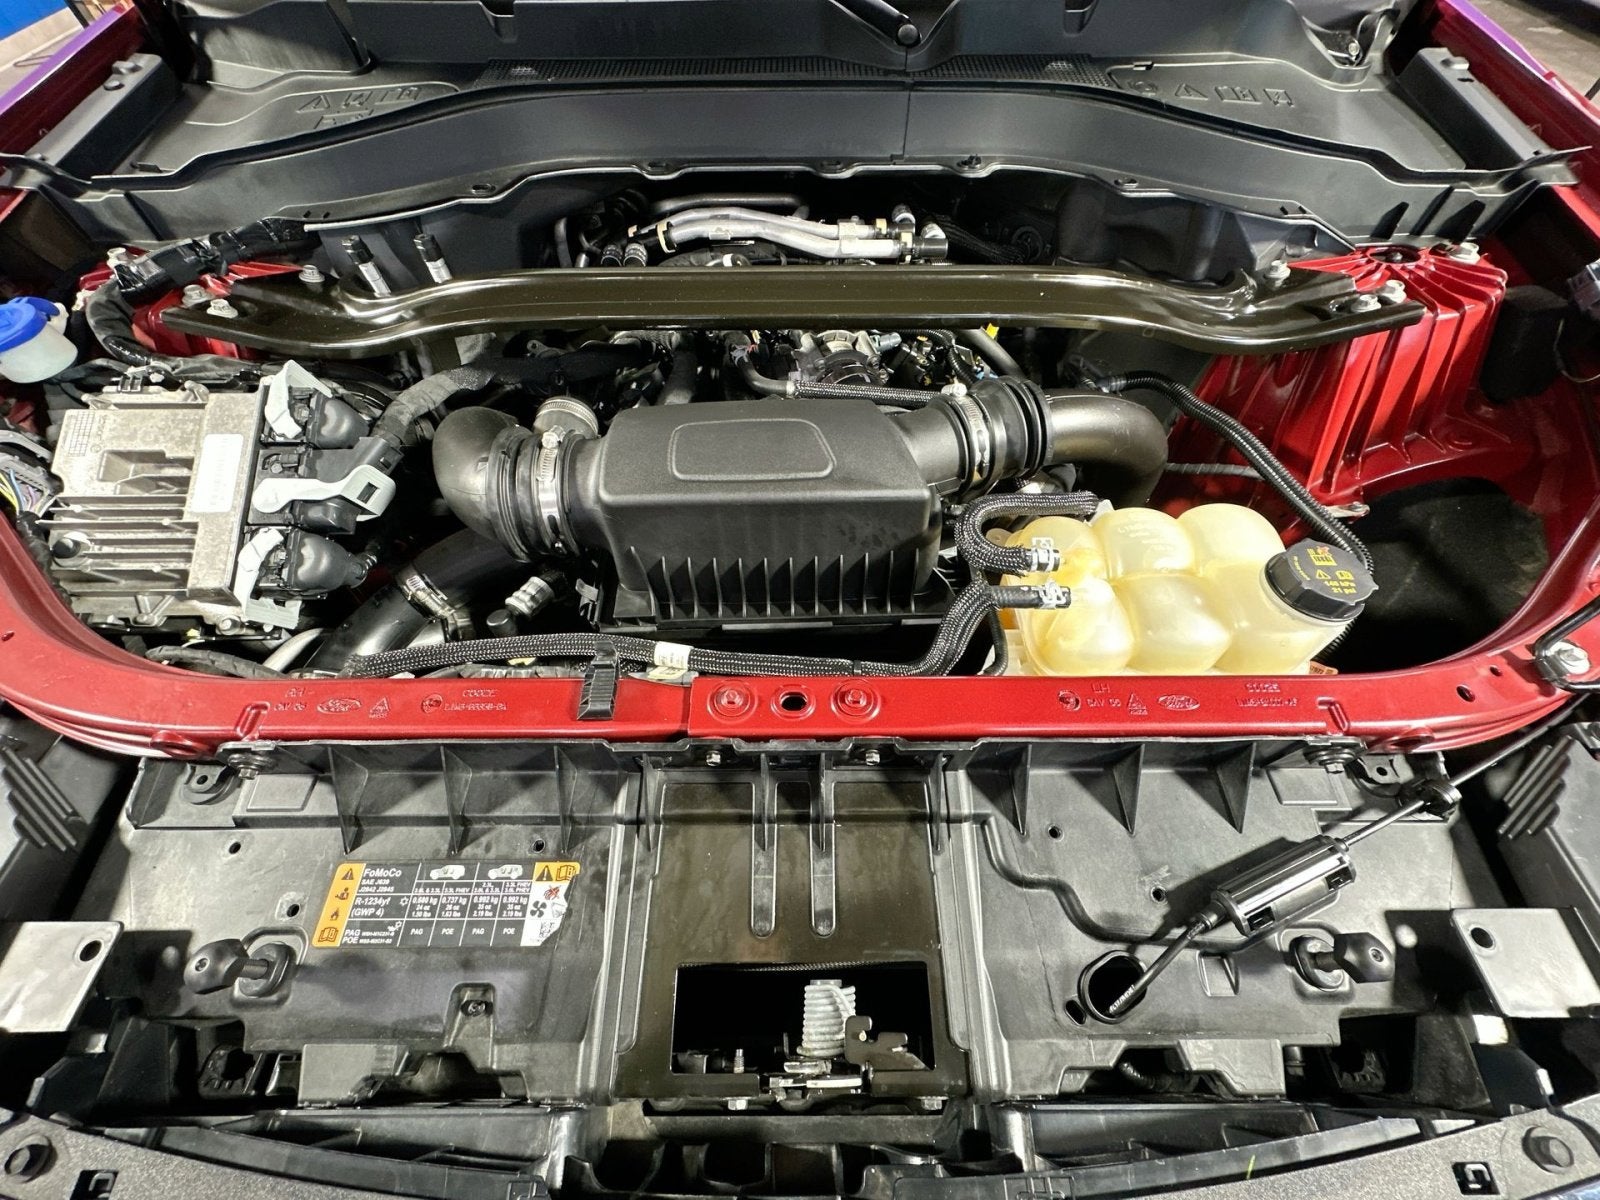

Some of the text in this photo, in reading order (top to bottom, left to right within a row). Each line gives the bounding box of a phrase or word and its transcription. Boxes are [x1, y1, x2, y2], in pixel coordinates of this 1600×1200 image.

[363, 868, 402, 878] FoMoCo
[354, 897, 391, 907] R-1234yf
[429, 896, 438, 905] kg
[459, 896, 467, 905] kg
[491, 896, 498, 904] kg
[520, 896, 528, 904] kg
[351, 908, 384, 917] (GWP 4)
[341, 936, 358, 944] POE
